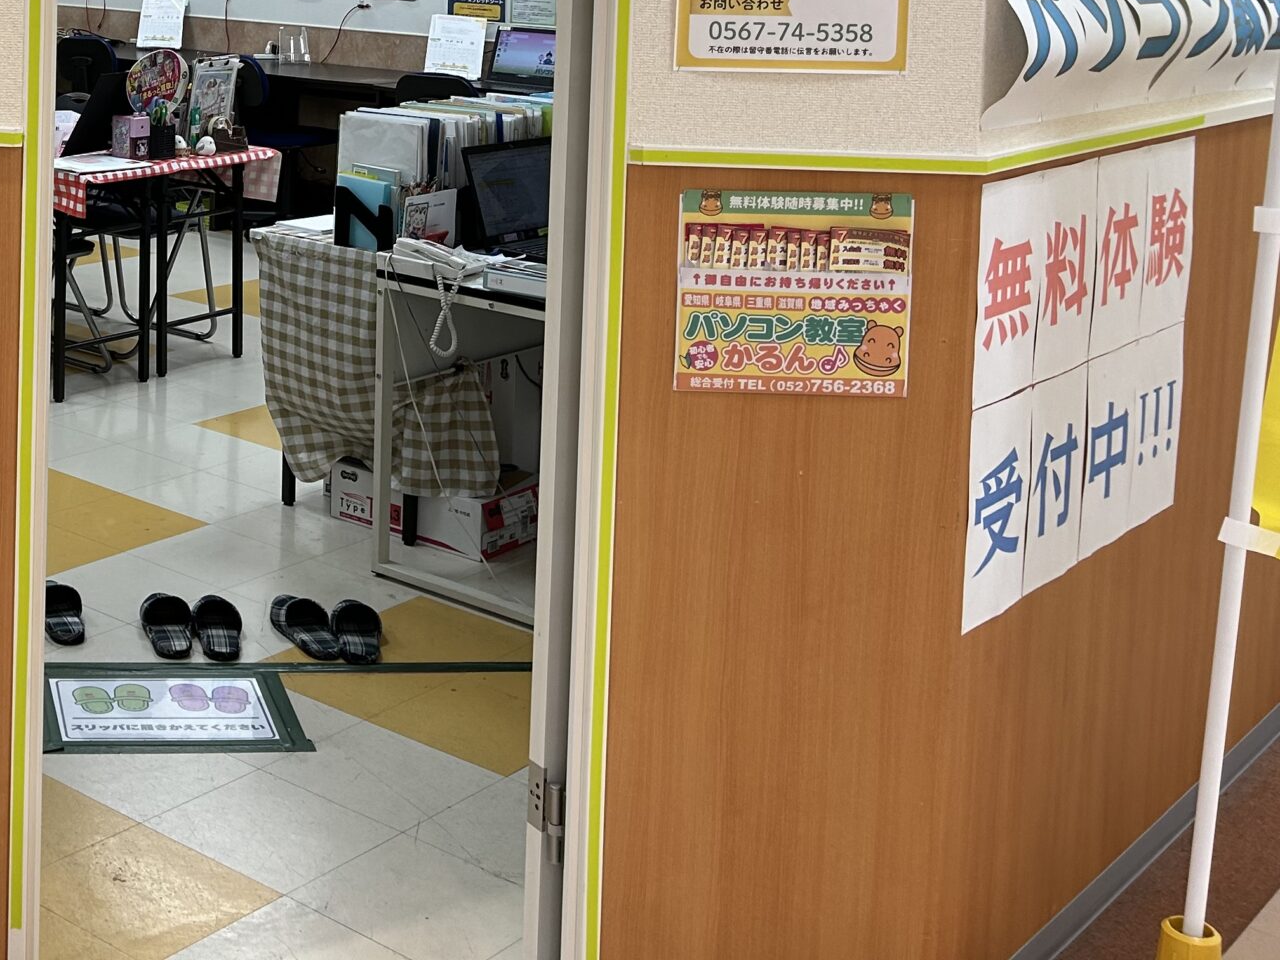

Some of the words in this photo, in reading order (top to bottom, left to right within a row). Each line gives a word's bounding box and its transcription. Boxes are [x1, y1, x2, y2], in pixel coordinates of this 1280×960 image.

[708, 21, 873, 44] 0567-74-5358
[729, 196, 864, 211] 無料体験随時募集中!!
[838, 230, 849, 242] 7
[983, 188, 1188, 352] 無料体験
[705, 273, 886, 290] 御自由にお持ち帰りください
[684, 294, 710, 306] 愛知県
[715, 295, 741, 308] 岐阜県
[746, 296, 772, 308] 三重県
[777, 297, 804, 310] 滋賀県
[810, 298, 904, 312] 地域みっちゃく
[684, 310, 867, 346] パソコン教室
[694, 358, 714, 370] 安心
[722, 341, 817, 374] かるん
[690, 376, 734, 389] 総合受付
[738, 378, 767, 391] TEL
[769, 377, 896, 395] (052)756-2368
[972, 380, 1178, 578] 受付中!!!
[339, 497, 366, 515] Type
